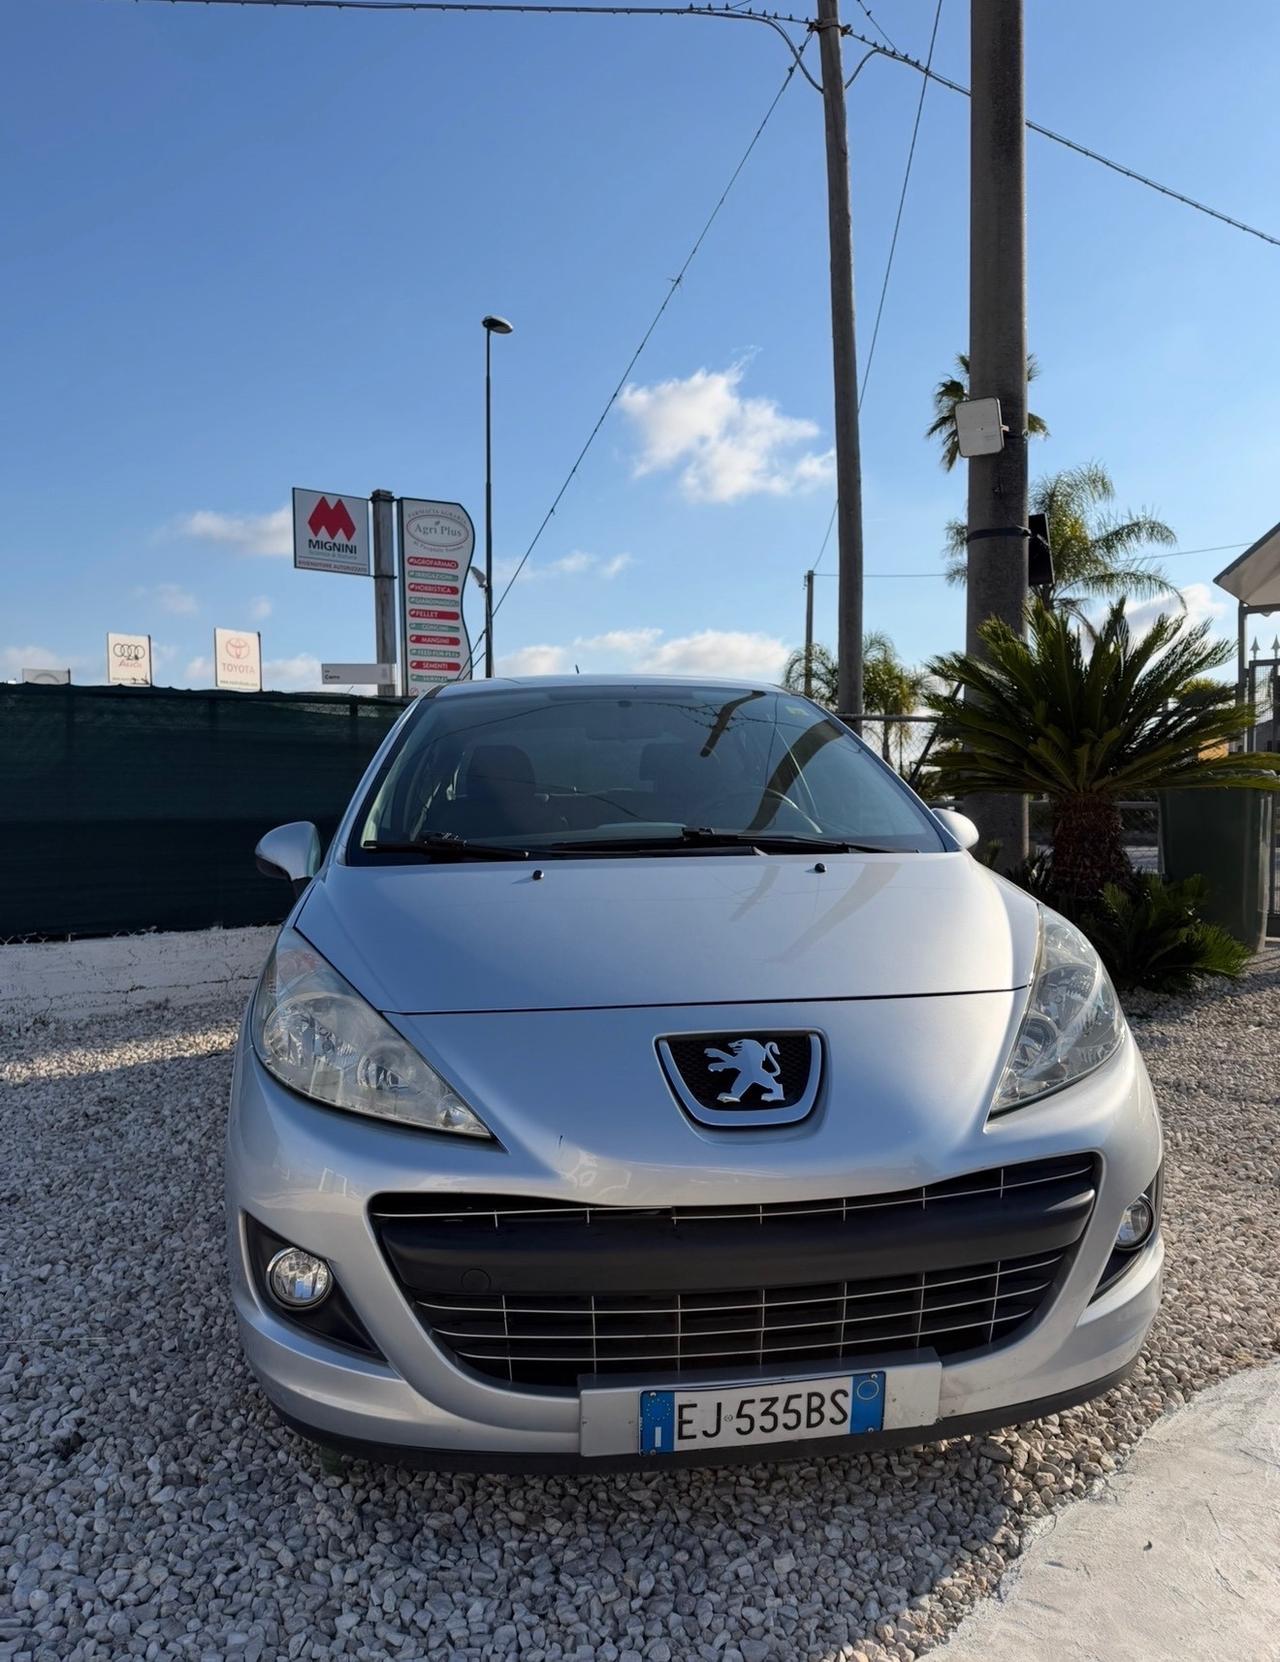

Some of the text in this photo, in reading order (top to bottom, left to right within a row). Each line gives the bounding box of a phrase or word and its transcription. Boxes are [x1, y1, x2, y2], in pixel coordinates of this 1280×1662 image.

[414, 523, 462, 537] Agri Plus
[308, 538, 357, 555] MIGNINI
[415, 610, 438, 618] PELLET
[222, 662, 256, 674] TOYOTA
[422, 662, 448, 670] SEMENTI
